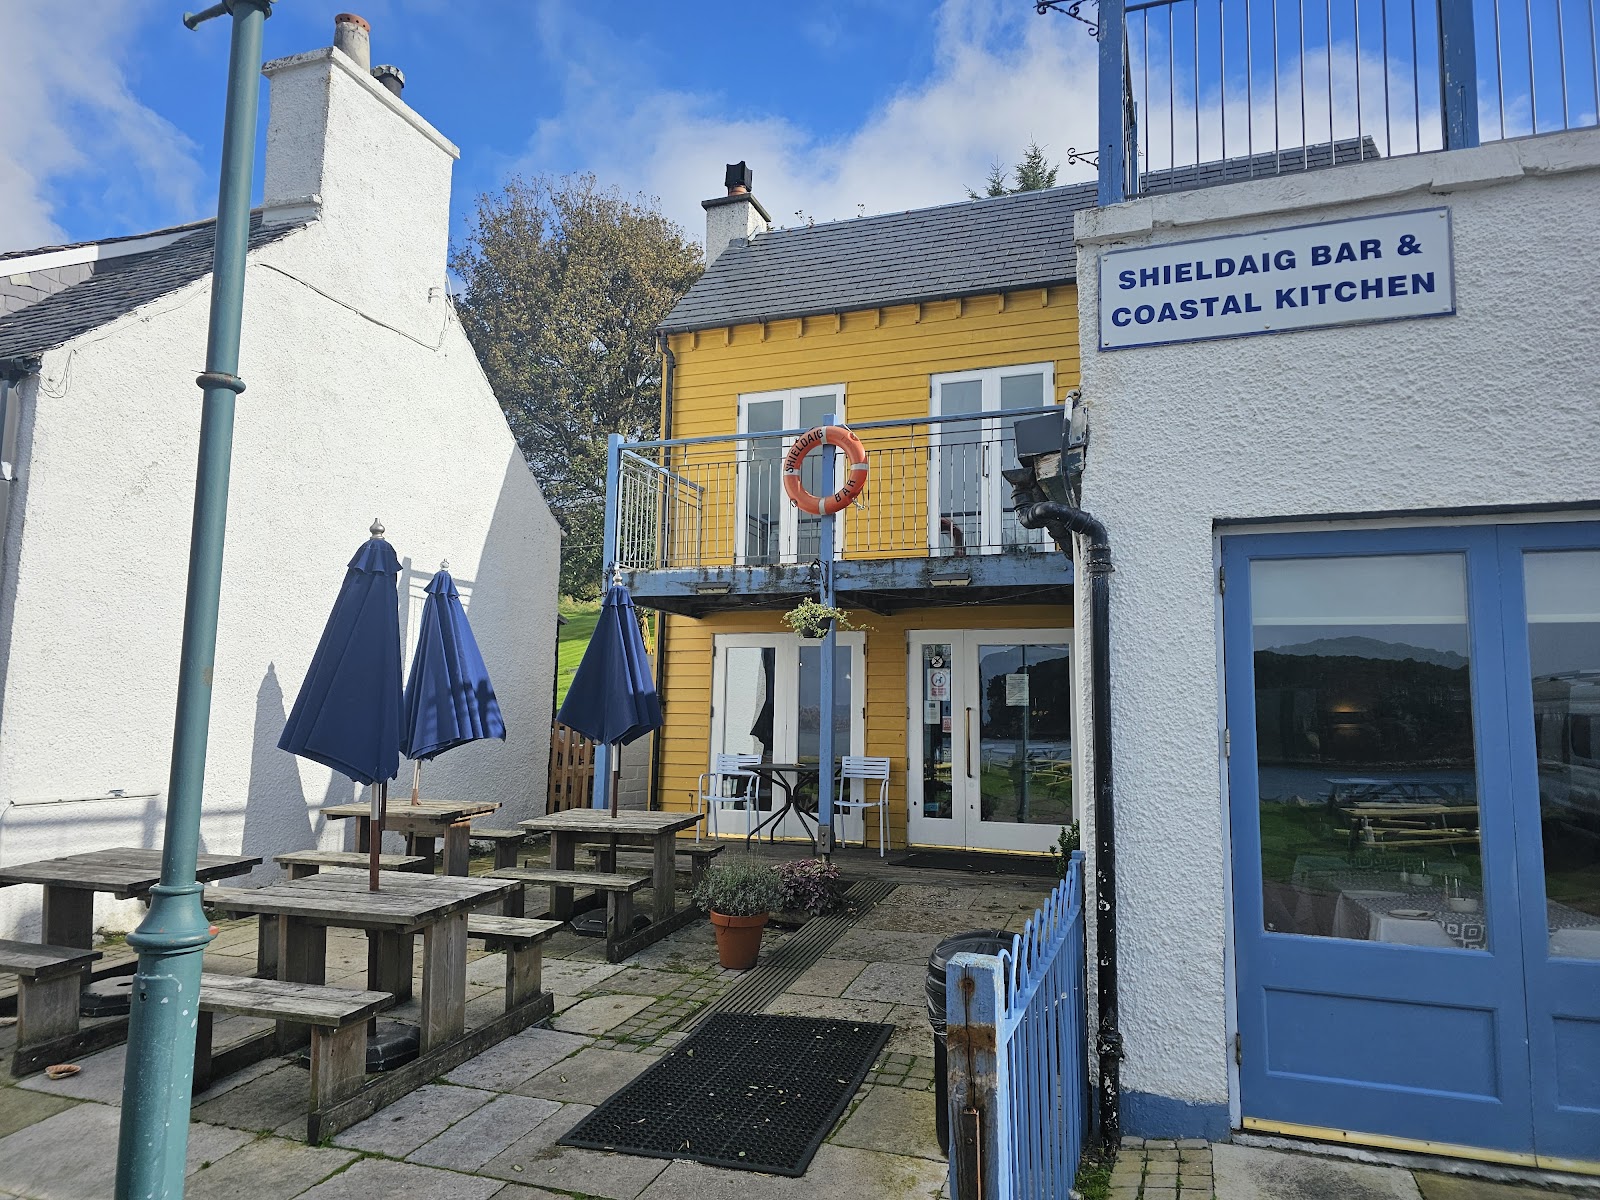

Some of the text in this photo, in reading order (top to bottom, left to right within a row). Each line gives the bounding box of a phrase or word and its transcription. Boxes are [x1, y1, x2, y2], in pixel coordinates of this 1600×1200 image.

[1118, 233, 1422, 290] SHIELDAIG BAR &
[1111, 271, 1436, 327] COASTAL KITCHEN
[785, 429, 824, 473] SHIELDAIG
[834, 479, 856, 503] BAR
